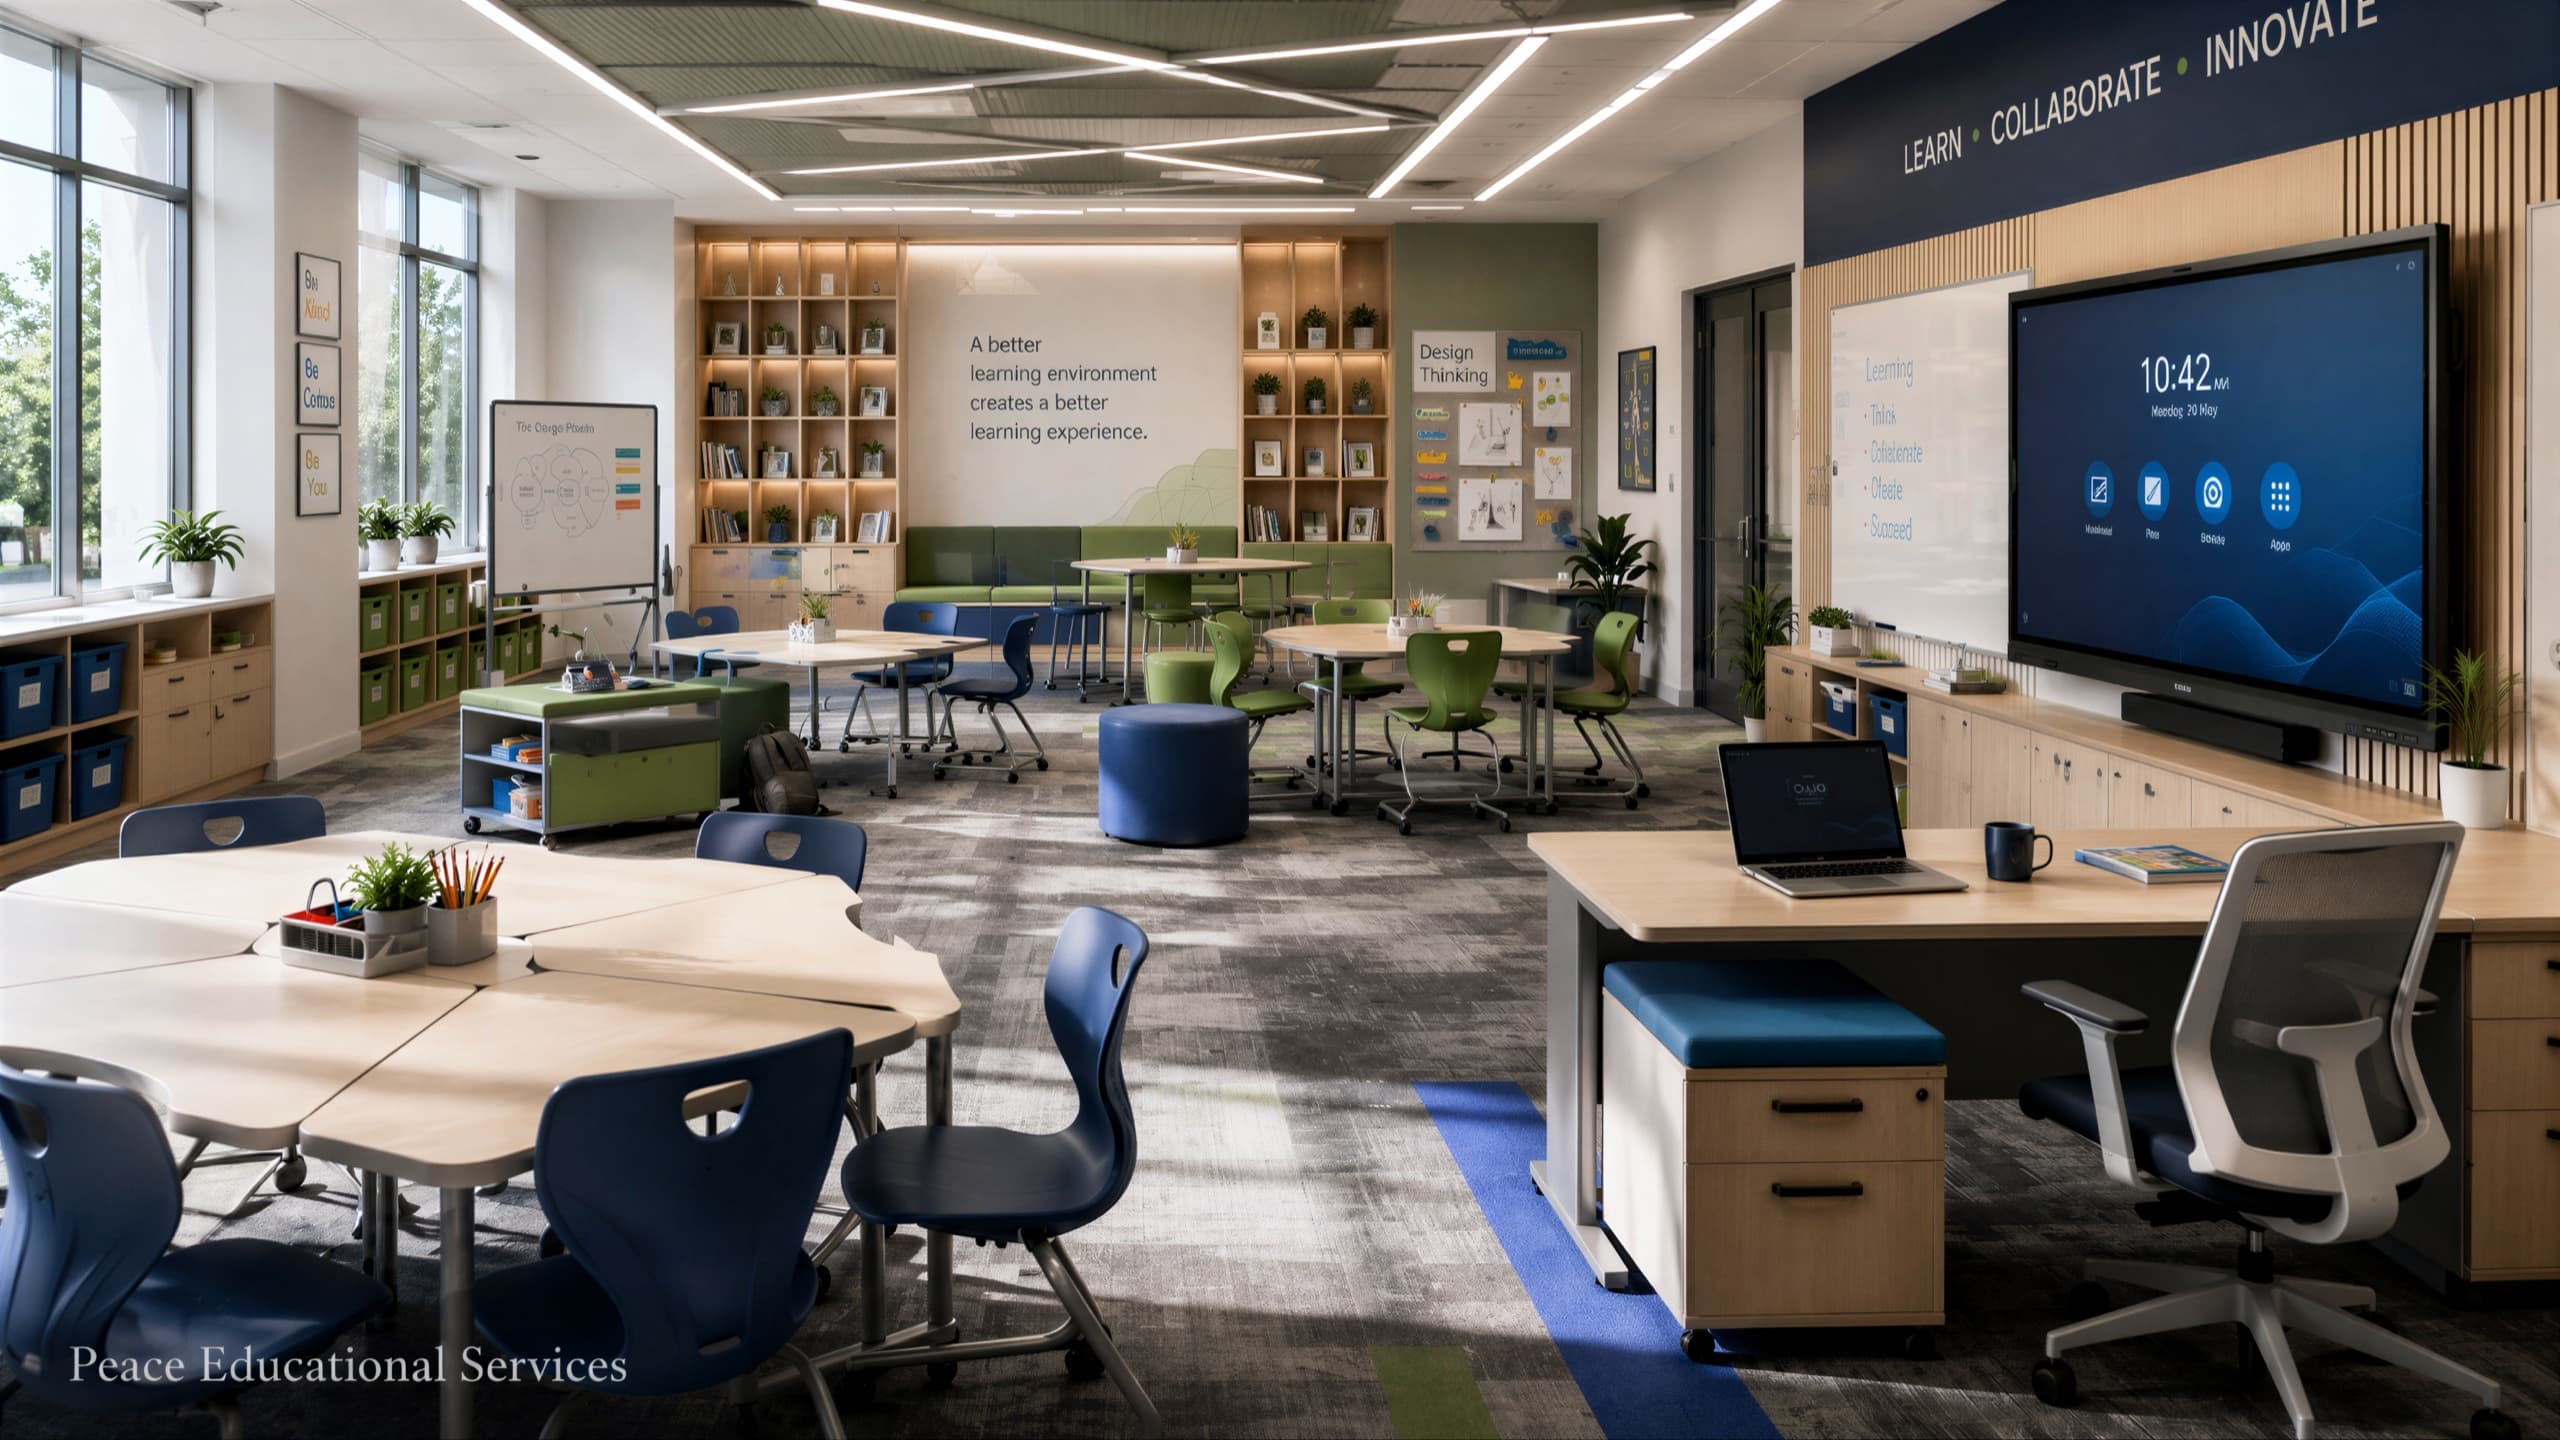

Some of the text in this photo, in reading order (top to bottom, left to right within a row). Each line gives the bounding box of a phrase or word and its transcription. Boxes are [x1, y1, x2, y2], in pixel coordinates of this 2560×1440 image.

[1904, 0, 2378, 174] LEARN COLLABORATE INNOVATE
[970, 336, 1042, 353] A better
[1420, 344, 1474, 364] Design
[970, 364, 1157, 386] learning environment
[1420, 367, 1489, 387] Thinking
[2141, 353, 2212, 394] 10:42
[970, 393, 1109, 411] creates a better
[1870, 403, 1897, 427] Think
[970, 422, 1148, 445] learning experience.
